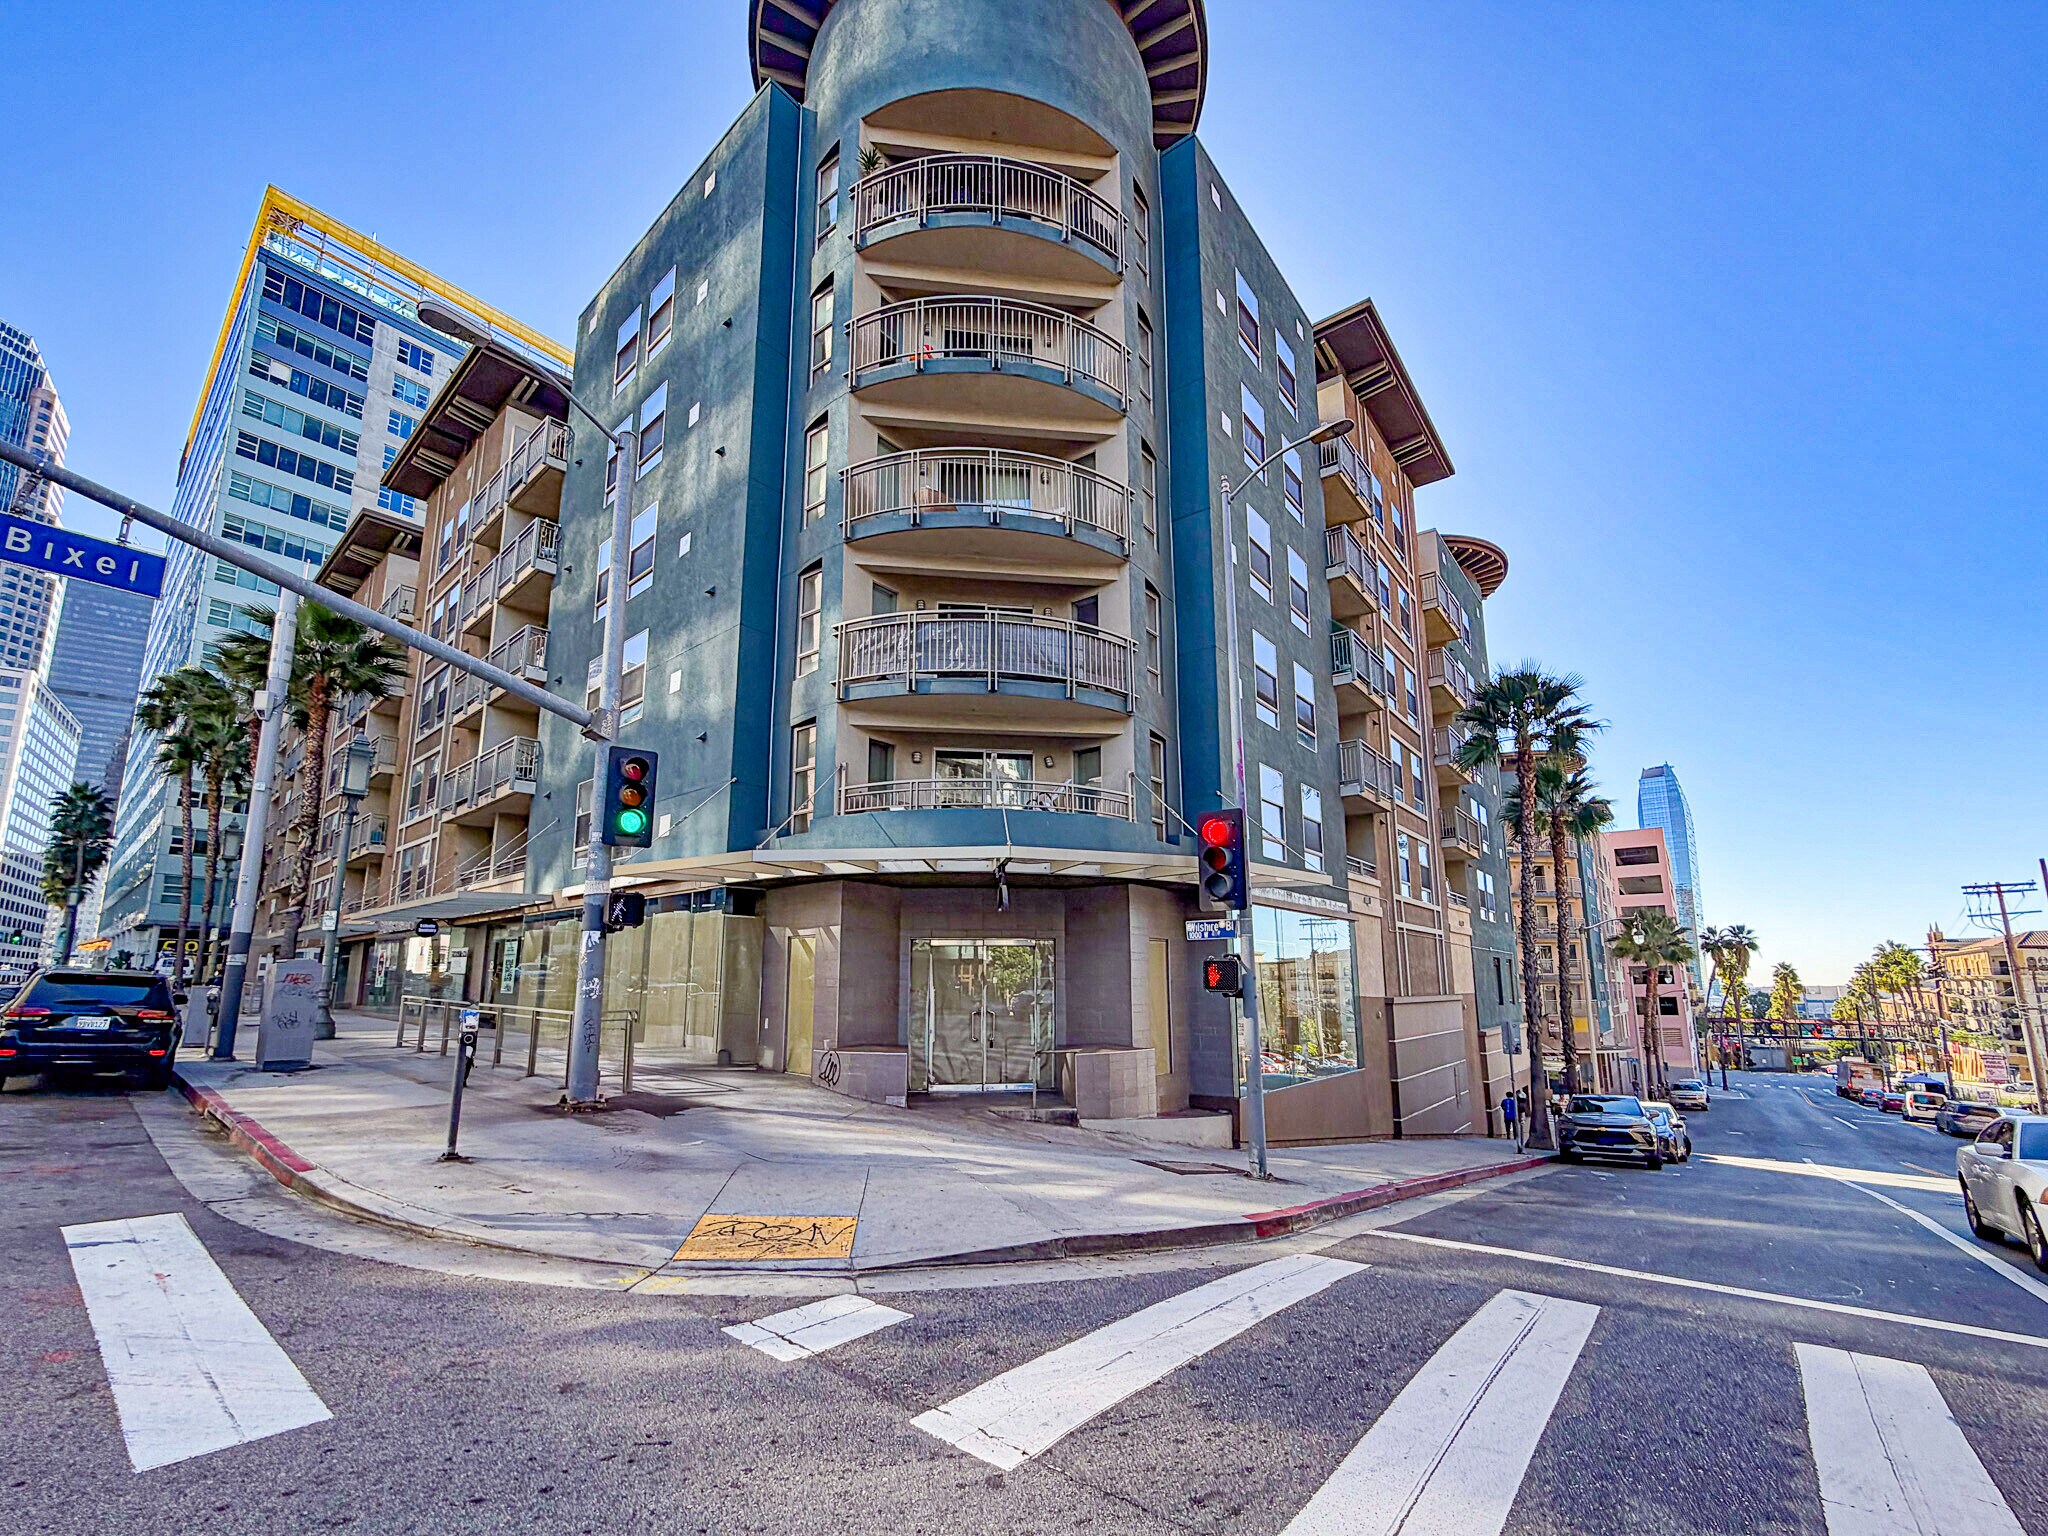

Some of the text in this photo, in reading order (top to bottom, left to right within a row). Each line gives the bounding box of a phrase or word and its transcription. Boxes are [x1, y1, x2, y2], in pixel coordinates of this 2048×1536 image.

[5, 526, 139, 582] Bixel
[1189, 920, 1234, 932] Wilshire Bl
